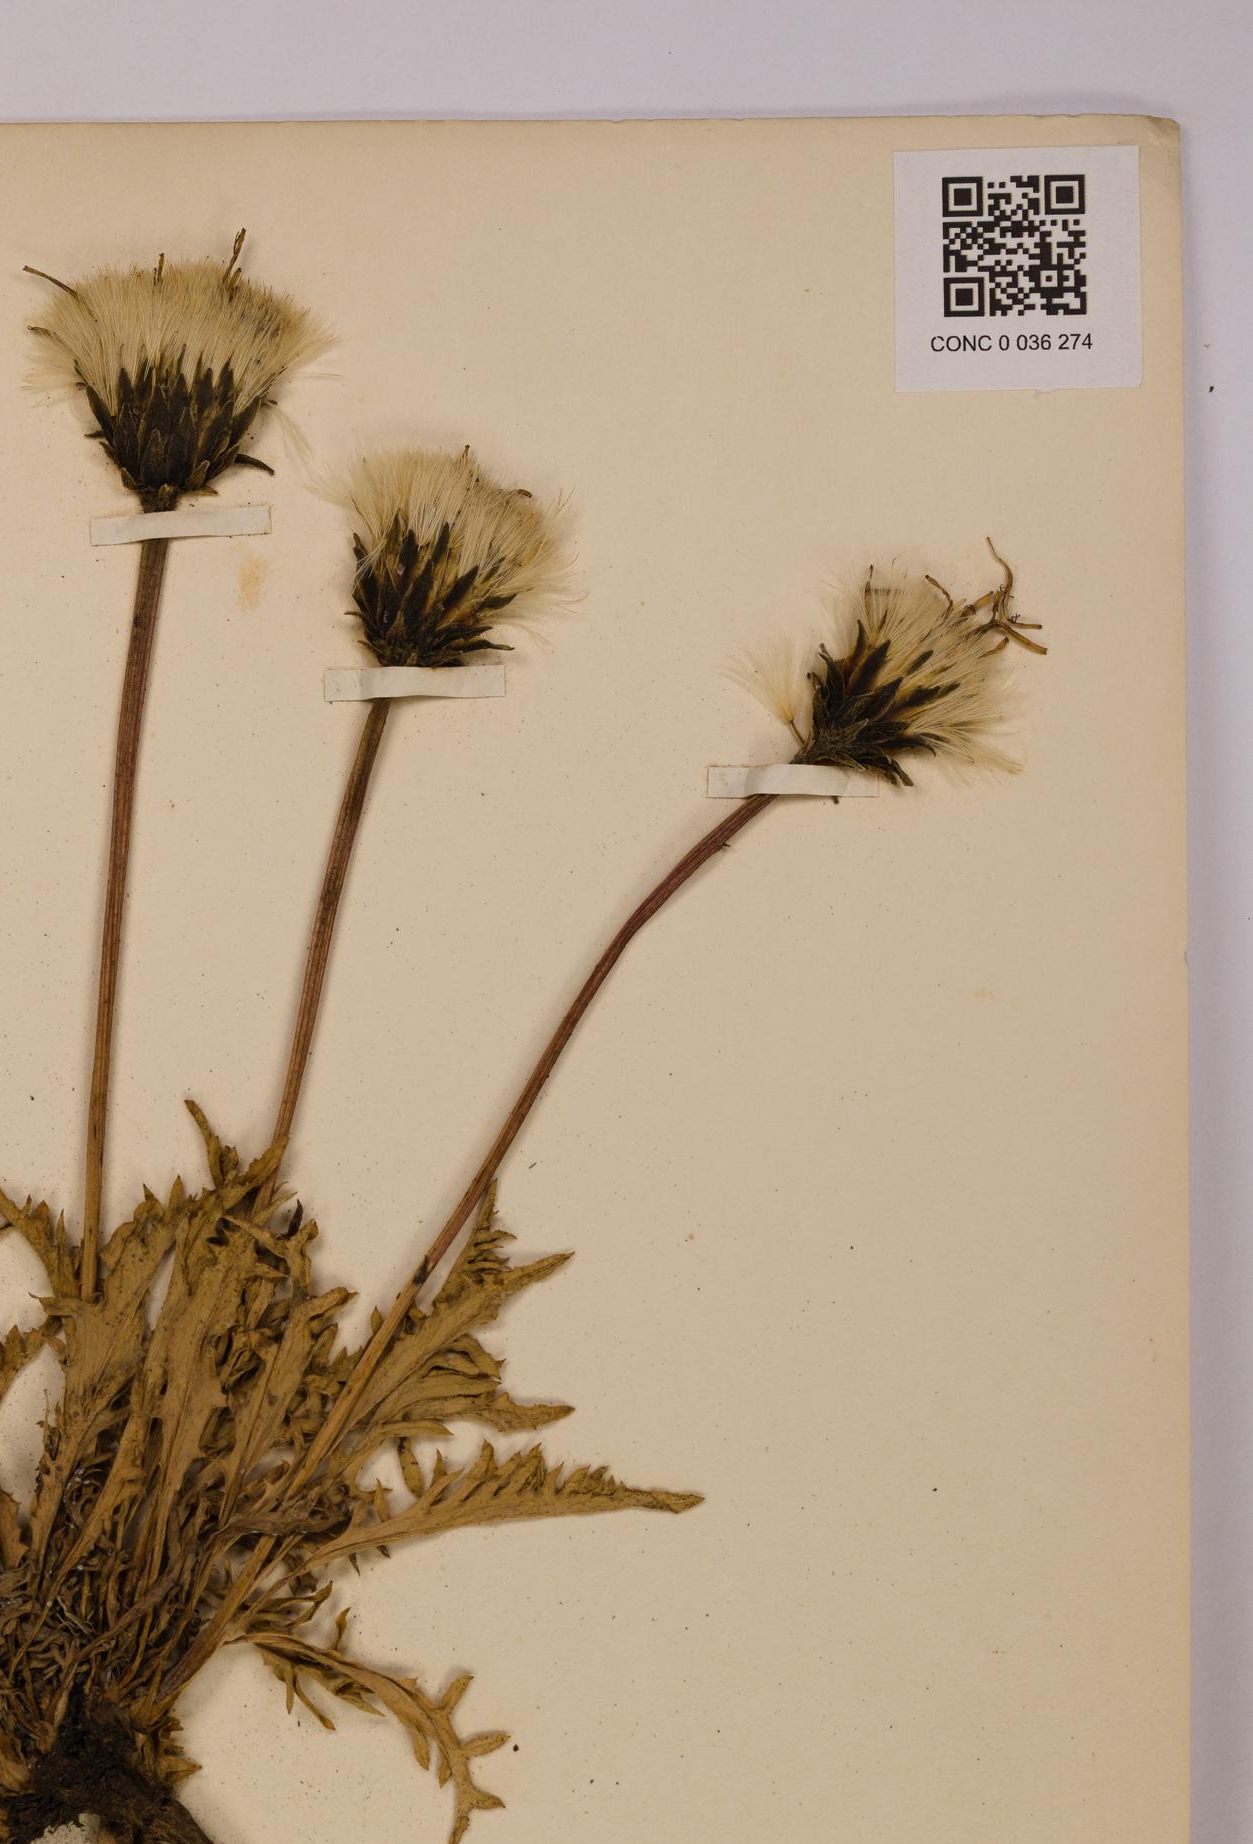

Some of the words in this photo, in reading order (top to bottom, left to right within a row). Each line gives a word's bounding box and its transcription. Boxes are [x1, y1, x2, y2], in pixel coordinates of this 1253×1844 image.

[930, 334, 993, 353] CONC
[999, 334, 1010, 352] 0
[1016, 333, 1052, 351] 036
[1058, 332, 1094, 351] 274
